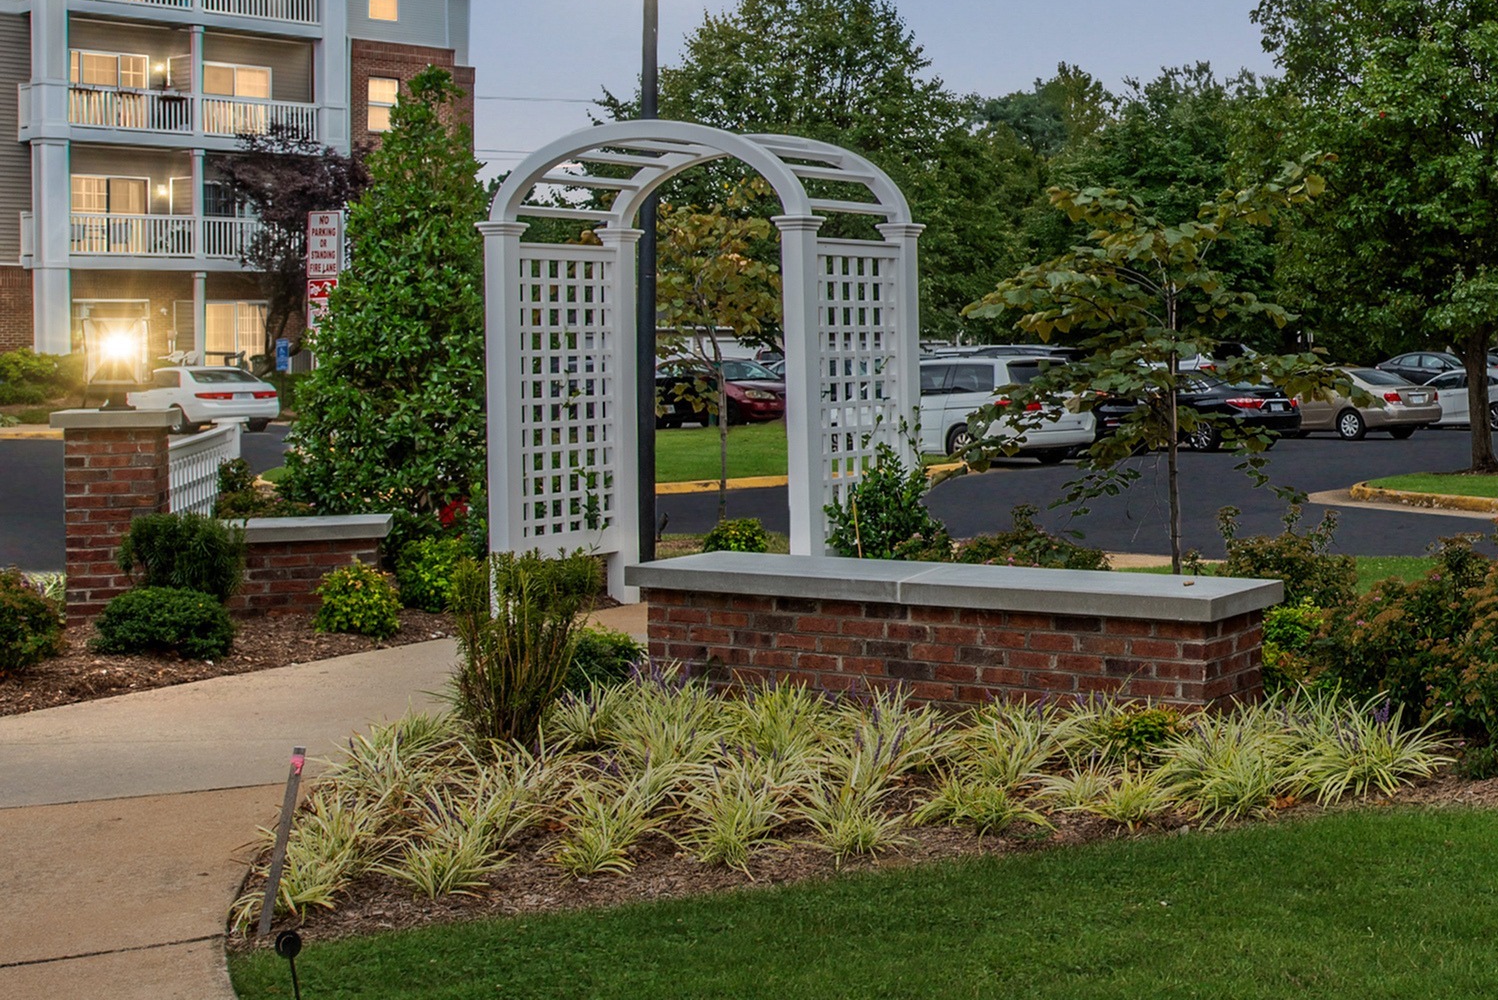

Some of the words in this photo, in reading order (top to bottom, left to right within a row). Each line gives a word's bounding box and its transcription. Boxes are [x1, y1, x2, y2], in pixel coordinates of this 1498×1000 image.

[319, 215, 329, 225] NO
[312, 227, 336, 236] PARKING
[320, 239, 328, 248] OR
[311, 250, 336, 260] STANDING
[310, 263, 321, 272] FIRE
[322, 263, 336, 273] LANE
